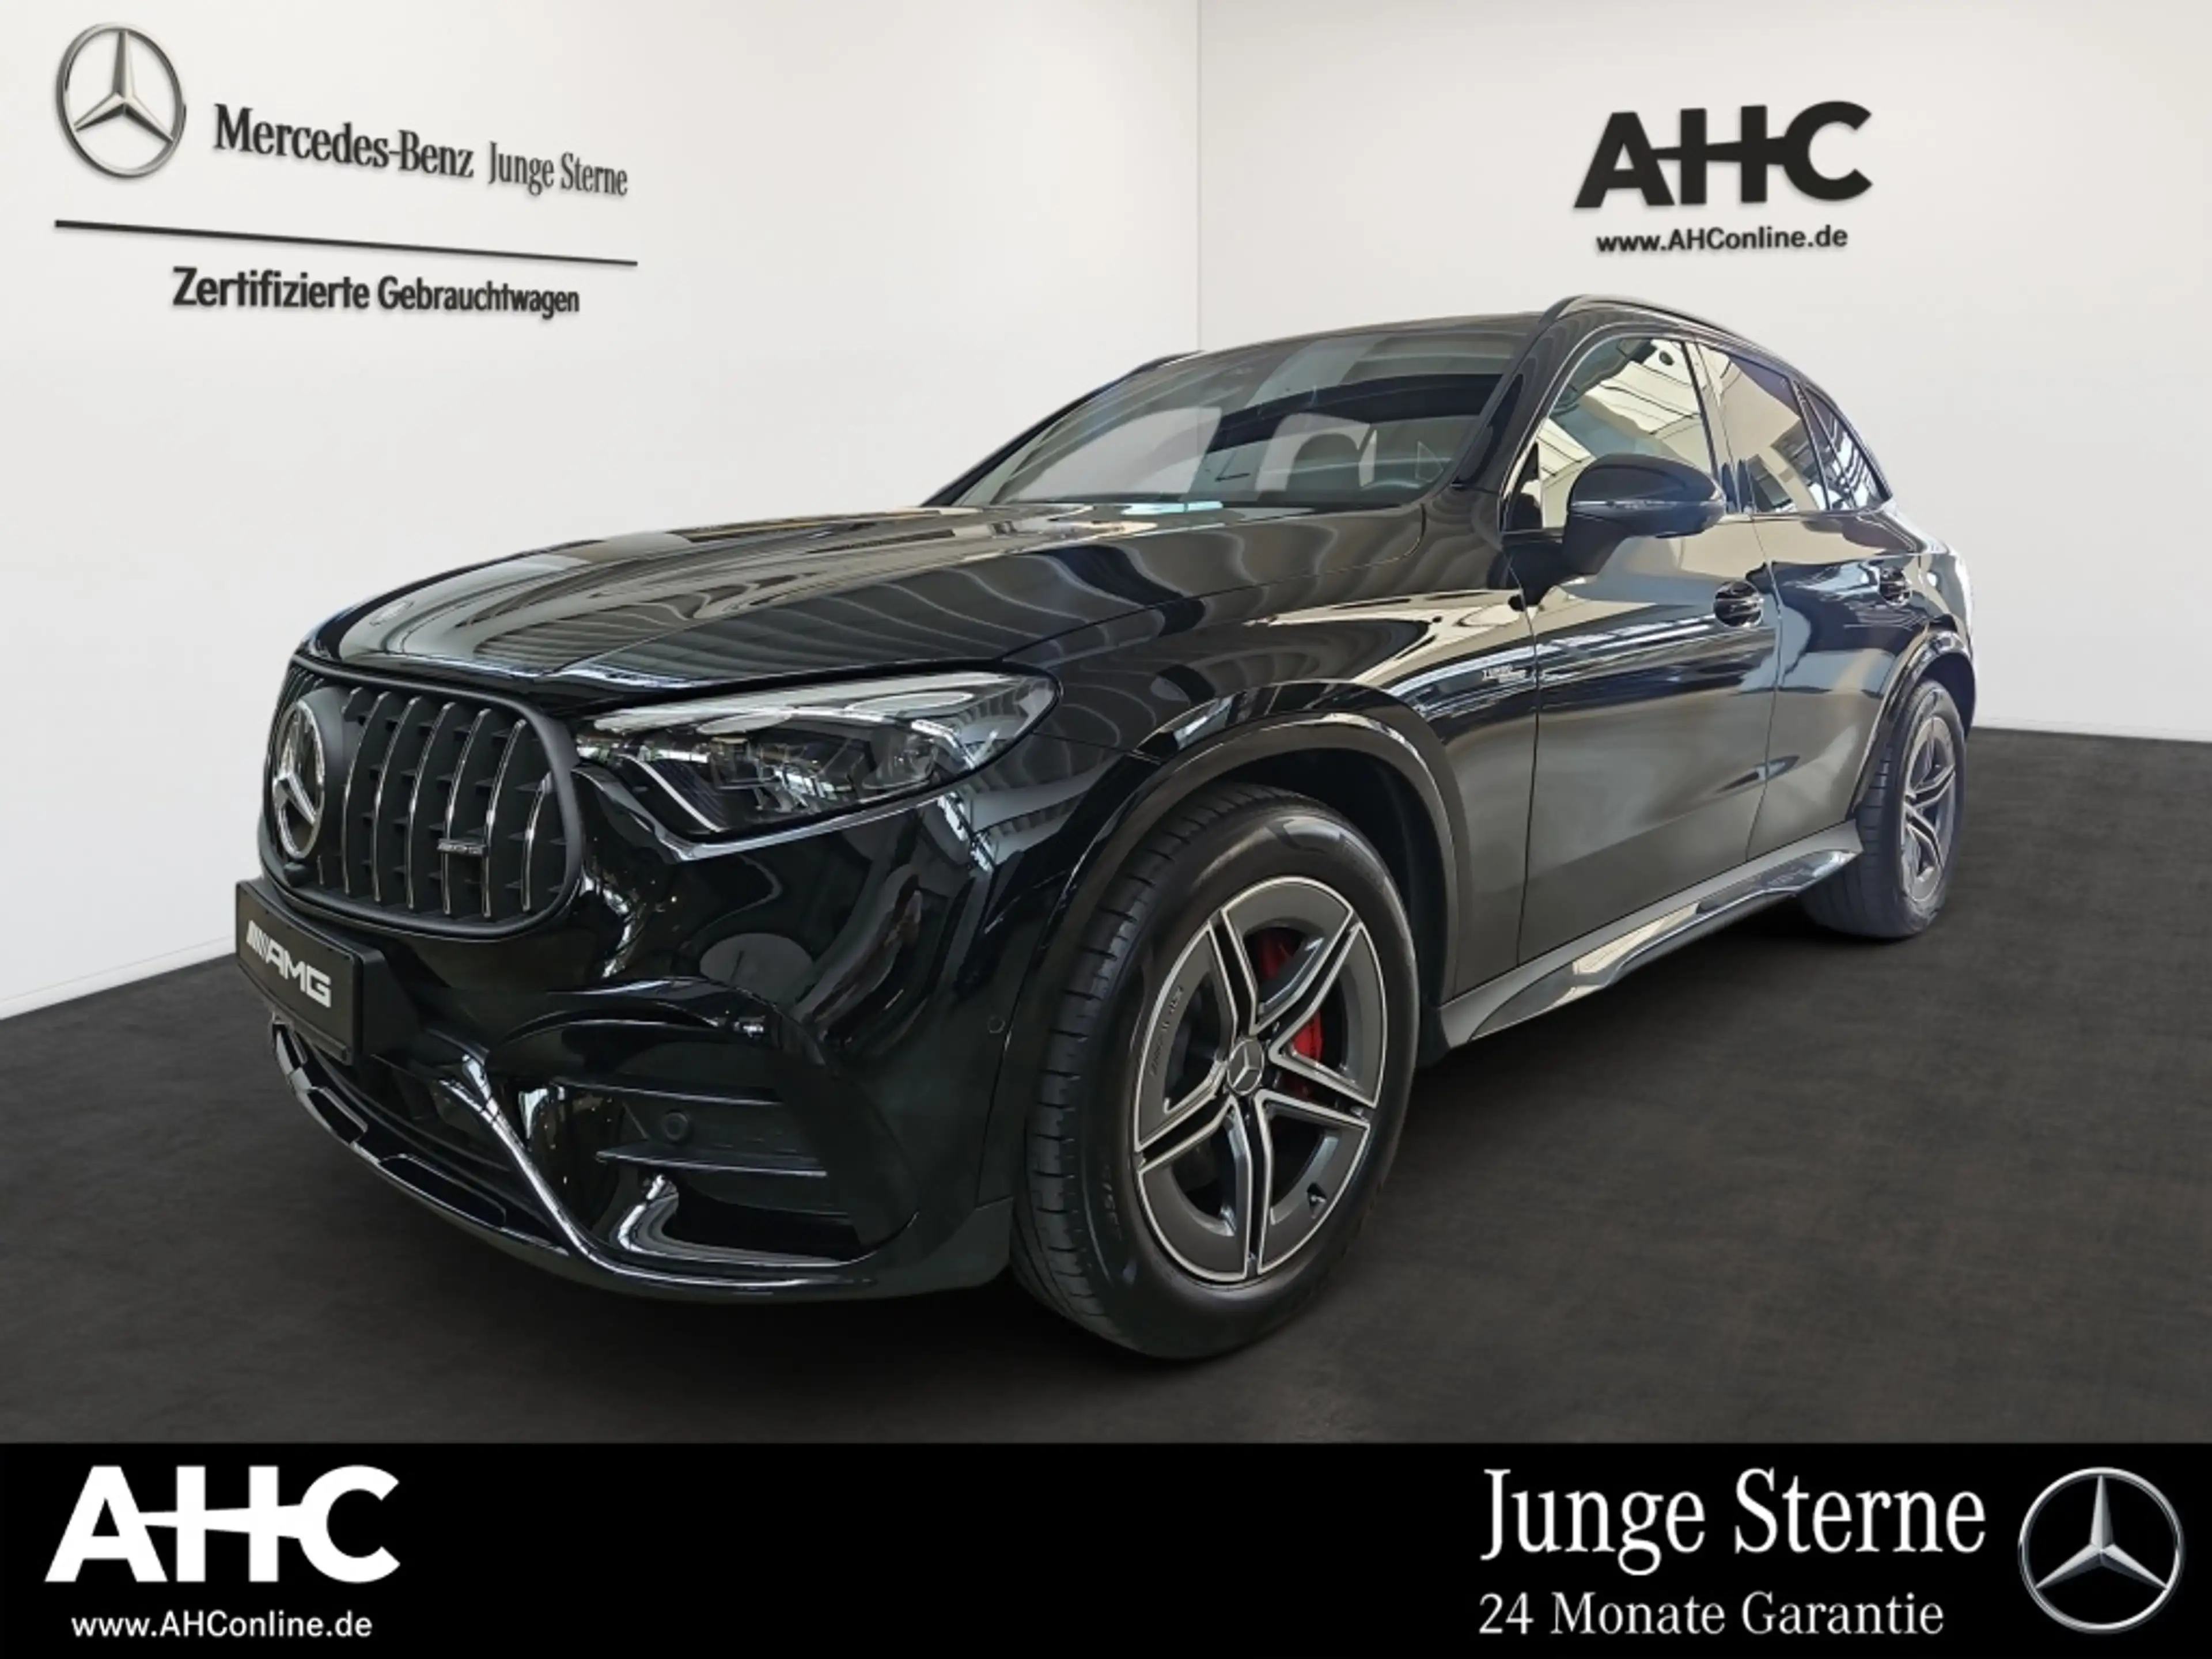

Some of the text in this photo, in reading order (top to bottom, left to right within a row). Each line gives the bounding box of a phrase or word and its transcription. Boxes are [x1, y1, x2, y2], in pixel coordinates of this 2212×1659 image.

[214, 103, 627, 196] Mercedes-Benz Junge Sterne
[1574, 101, 1873, 209] AHC
[1596, 224, 1848, 253] www.AHConline.de
[172, 266, 579, 320] Zertifizierte Gebrauchtwagen
[265, 938, 331, 1008] AMG
